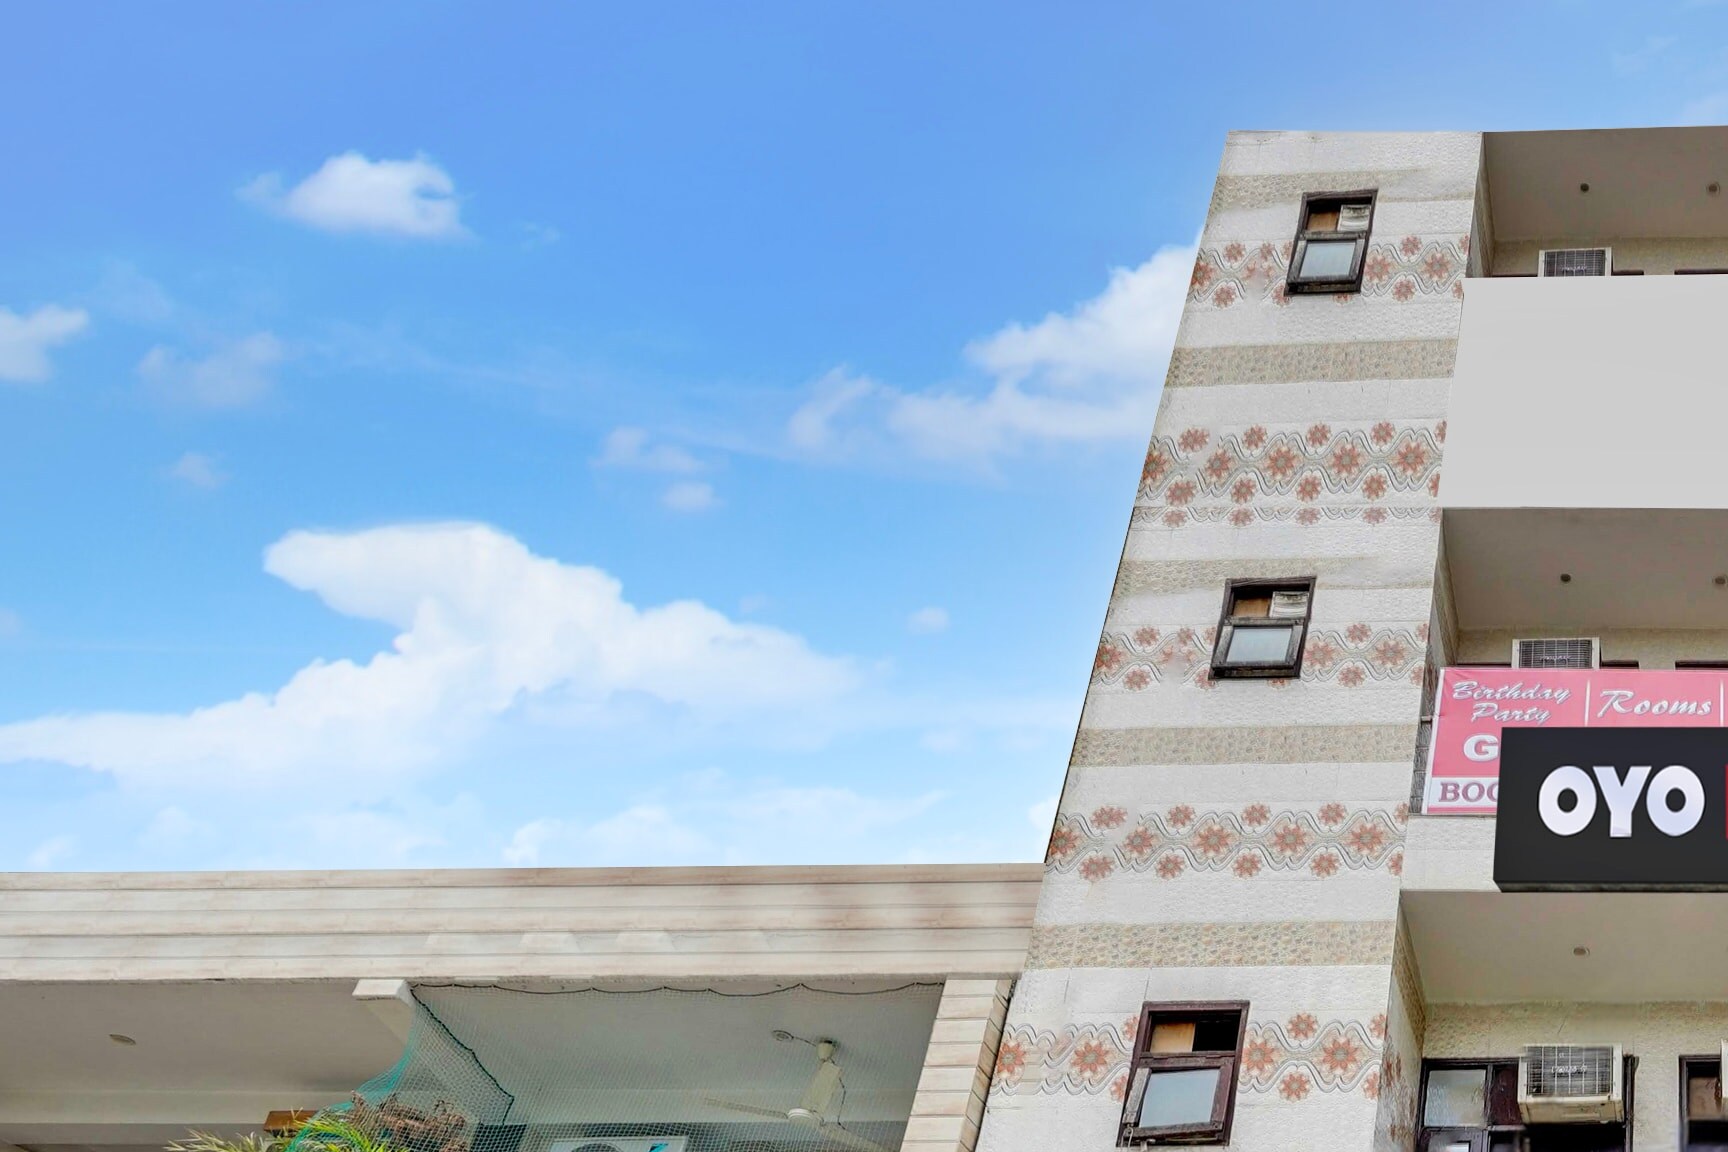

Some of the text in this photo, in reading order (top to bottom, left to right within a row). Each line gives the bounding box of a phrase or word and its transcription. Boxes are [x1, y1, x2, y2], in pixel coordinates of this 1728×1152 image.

[1452, 681, 1571, 704] Birthday
[1596, 690, 1713, 718] Rooms
[1471, 702, 1551, 724] Party
[1538, 765, 1705, 837] OYO
